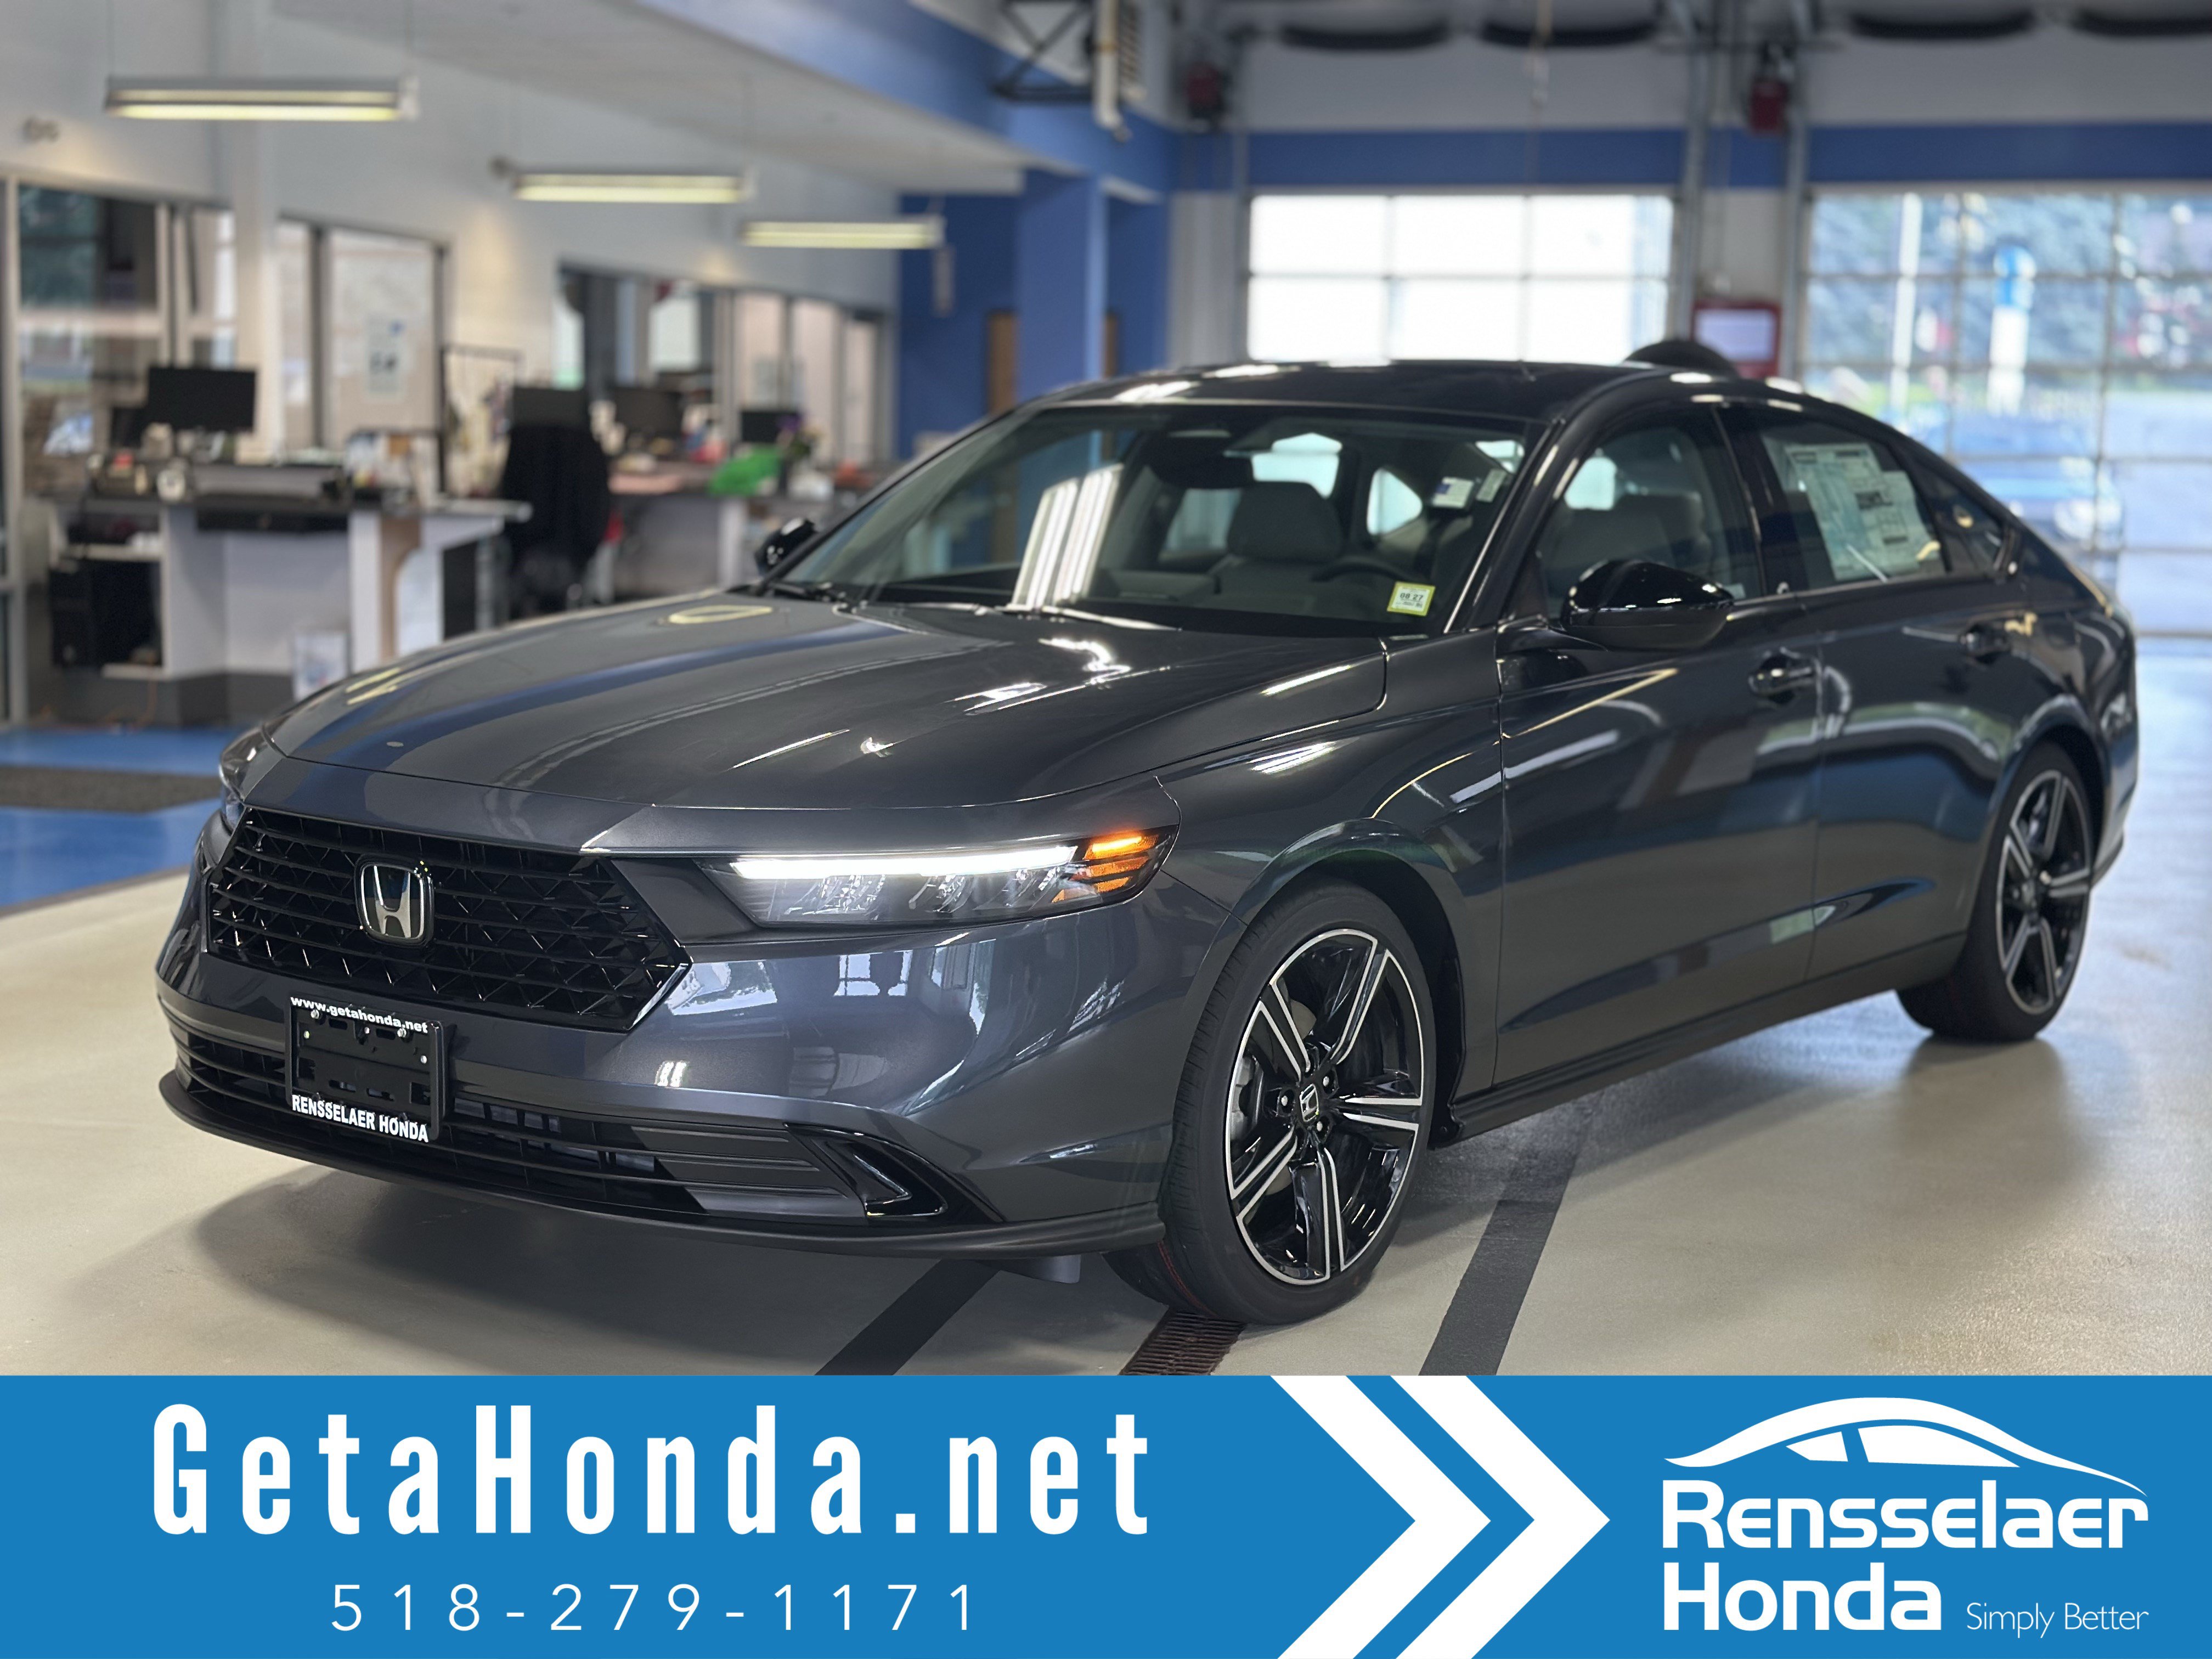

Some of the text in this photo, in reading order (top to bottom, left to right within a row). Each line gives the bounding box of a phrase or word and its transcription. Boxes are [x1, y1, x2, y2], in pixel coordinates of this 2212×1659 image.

[290, 996, 428, 1034] www.getahonda.net
[291, 1094, 429, 1143] RENSSELAER HONDA
